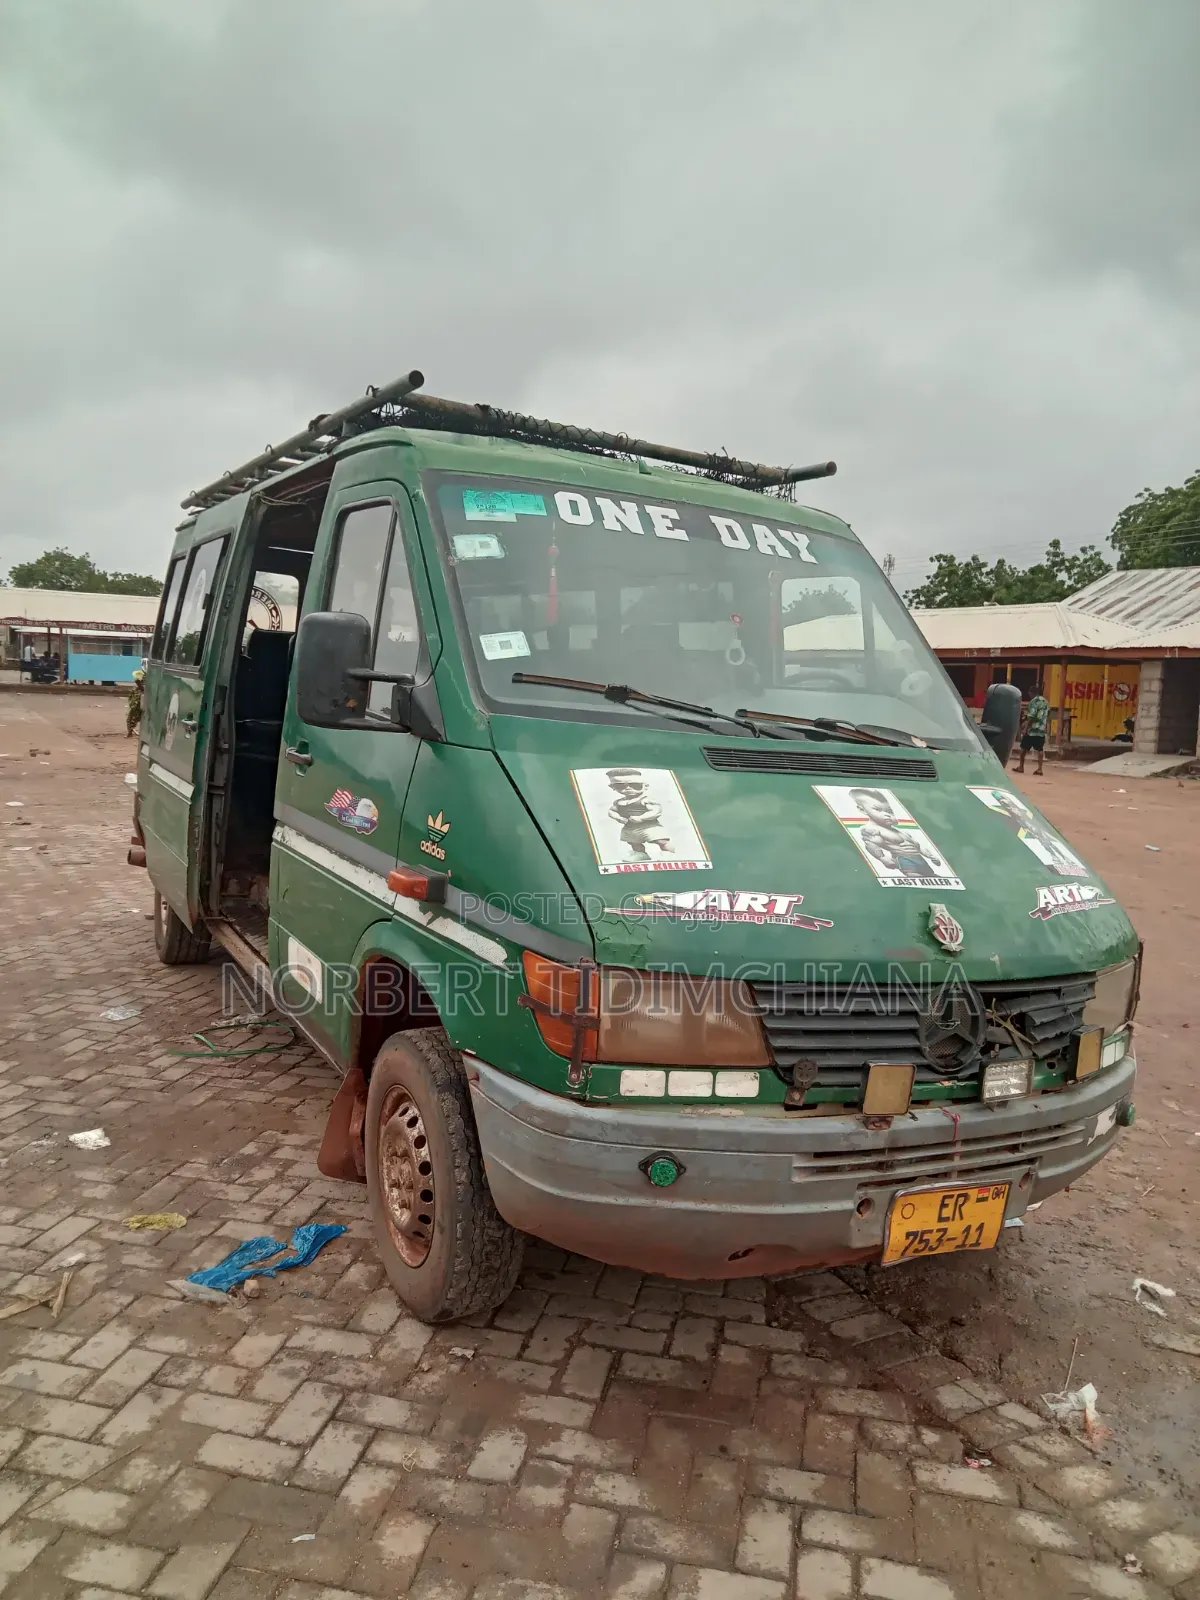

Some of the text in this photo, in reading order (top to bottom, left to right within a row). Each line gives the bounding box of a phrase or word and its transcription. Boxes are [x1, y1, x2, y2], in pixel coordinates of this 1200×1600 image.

[554, 491, 818, 564] ONE DAY
[83, 622, 116, 631] METRO
[121, 624, 147, 632] MASS
[420, 840, 446, 861] adidas
[616, 861, 698, 873] LAST KILLER
[891, 878, 952, 887] LAST KILLER
[692, 889, 802, 915] ART
[1037, 883, 1082, 909] ART
[719, 912, 763, 923] Racing
[767, 914, 796, 924] Tour
[937, 1192, 971, 1223] ER
[901, 1222, 985, 1257] 753-11
